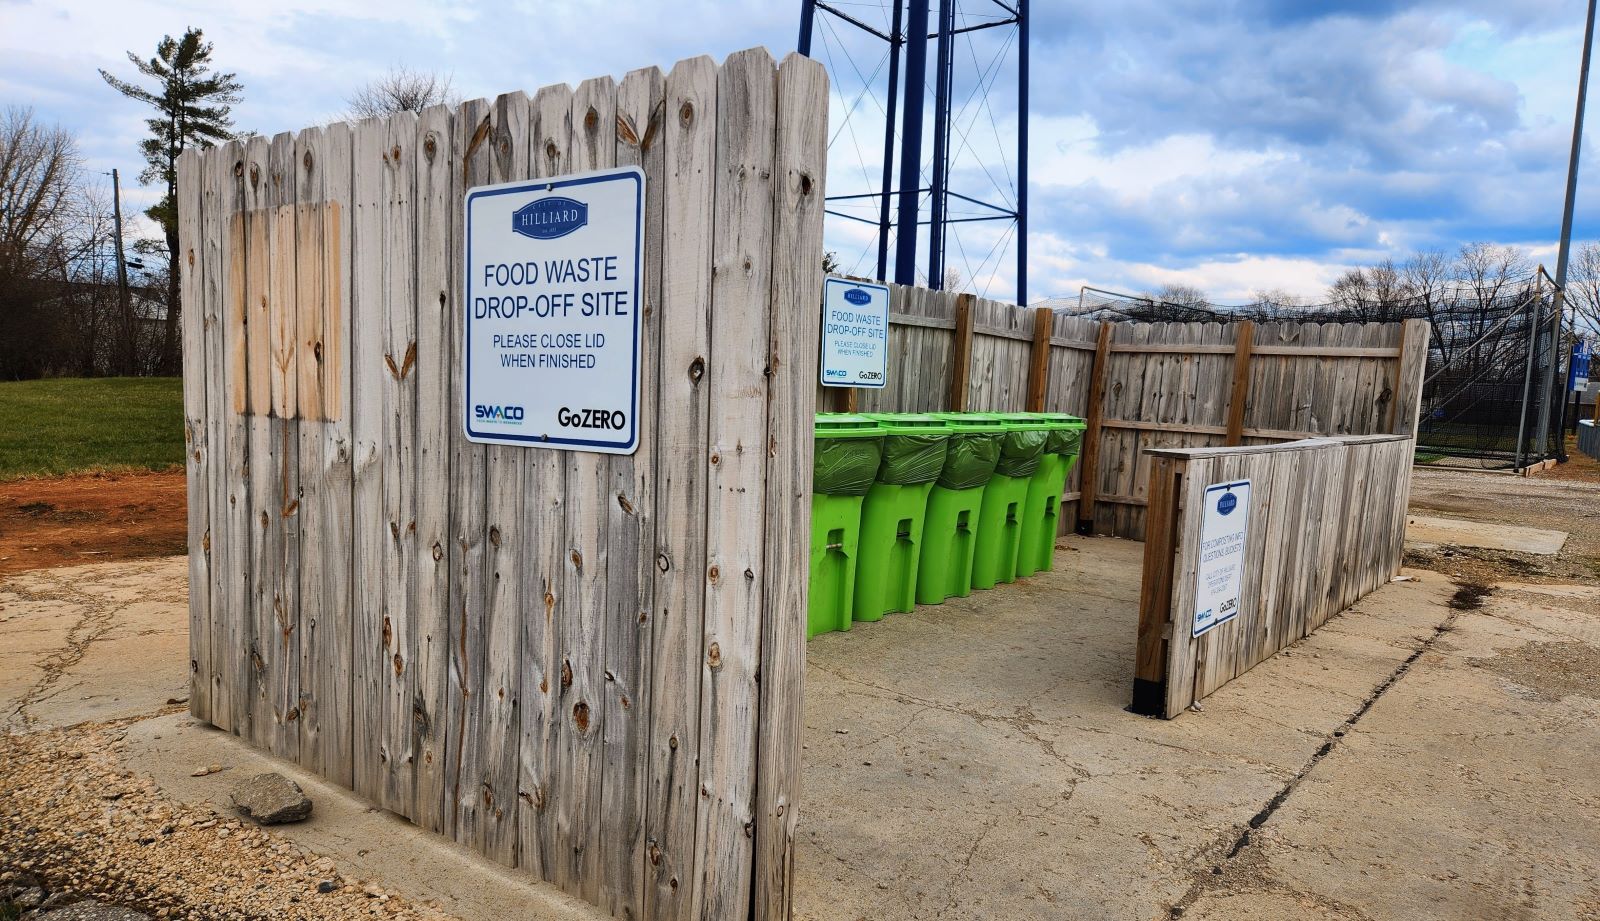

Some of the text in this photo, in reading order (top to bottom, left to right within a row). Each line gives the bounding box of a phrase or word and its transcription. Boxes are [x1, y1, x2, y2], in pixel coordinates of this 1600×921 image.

[521, 209, 578, 226] HILLIARD
[484, 256, 618, 287] FOOD WASTE
[474, 291, 628, 319] DROP-OFF SITE
[832, 310, 880, 326] FOOD WASTE
[827, 324, 884, 339] DROP-OFF SITE
[493, 333, 605, 349] PLEASE CLOSE LID
[834, 340, 853, 348] PLEASE
[853, 342, 869, 350] CLOSE
[500, 353, 596, 369] WHEN FINISHED
[852, 350, 874, 358] FINISHED
[858, 371, 882, 380] GoZERO
[475, 404, 524, 420] SWACO
[558, 407, 626, 430] GoZERO
